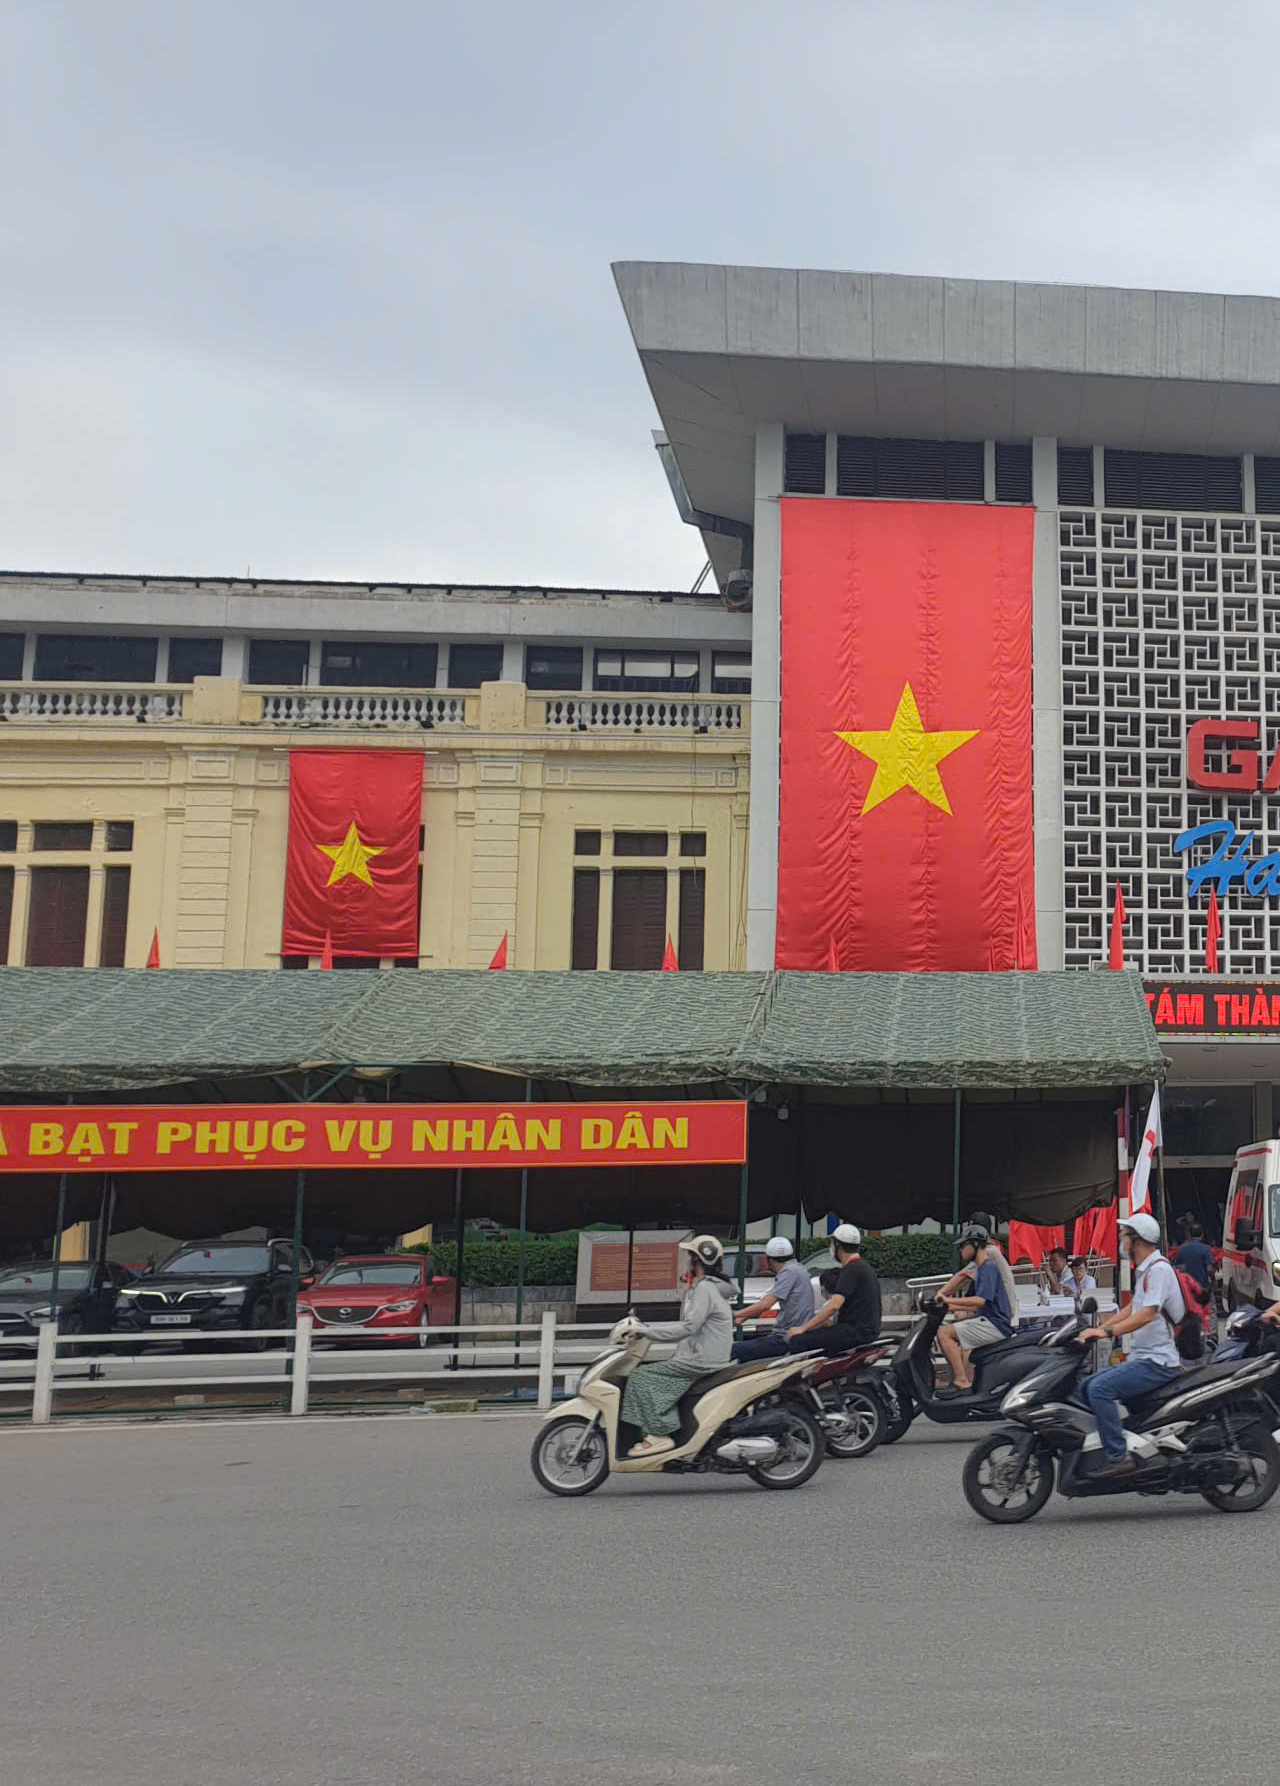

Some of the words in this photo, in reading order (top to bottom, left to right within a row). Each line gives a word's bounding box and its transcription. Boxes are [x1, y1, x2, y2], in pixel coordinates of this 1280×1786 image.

[28, 1122, 139, 1162] BẠT
[156, 1119, 306, 1160] PHỤC
[325, 1119, 393, 1159] VỤ
[411, 1112, 562, 1152] NHÂN
[580, 1110, 689, 1150] DÂN
